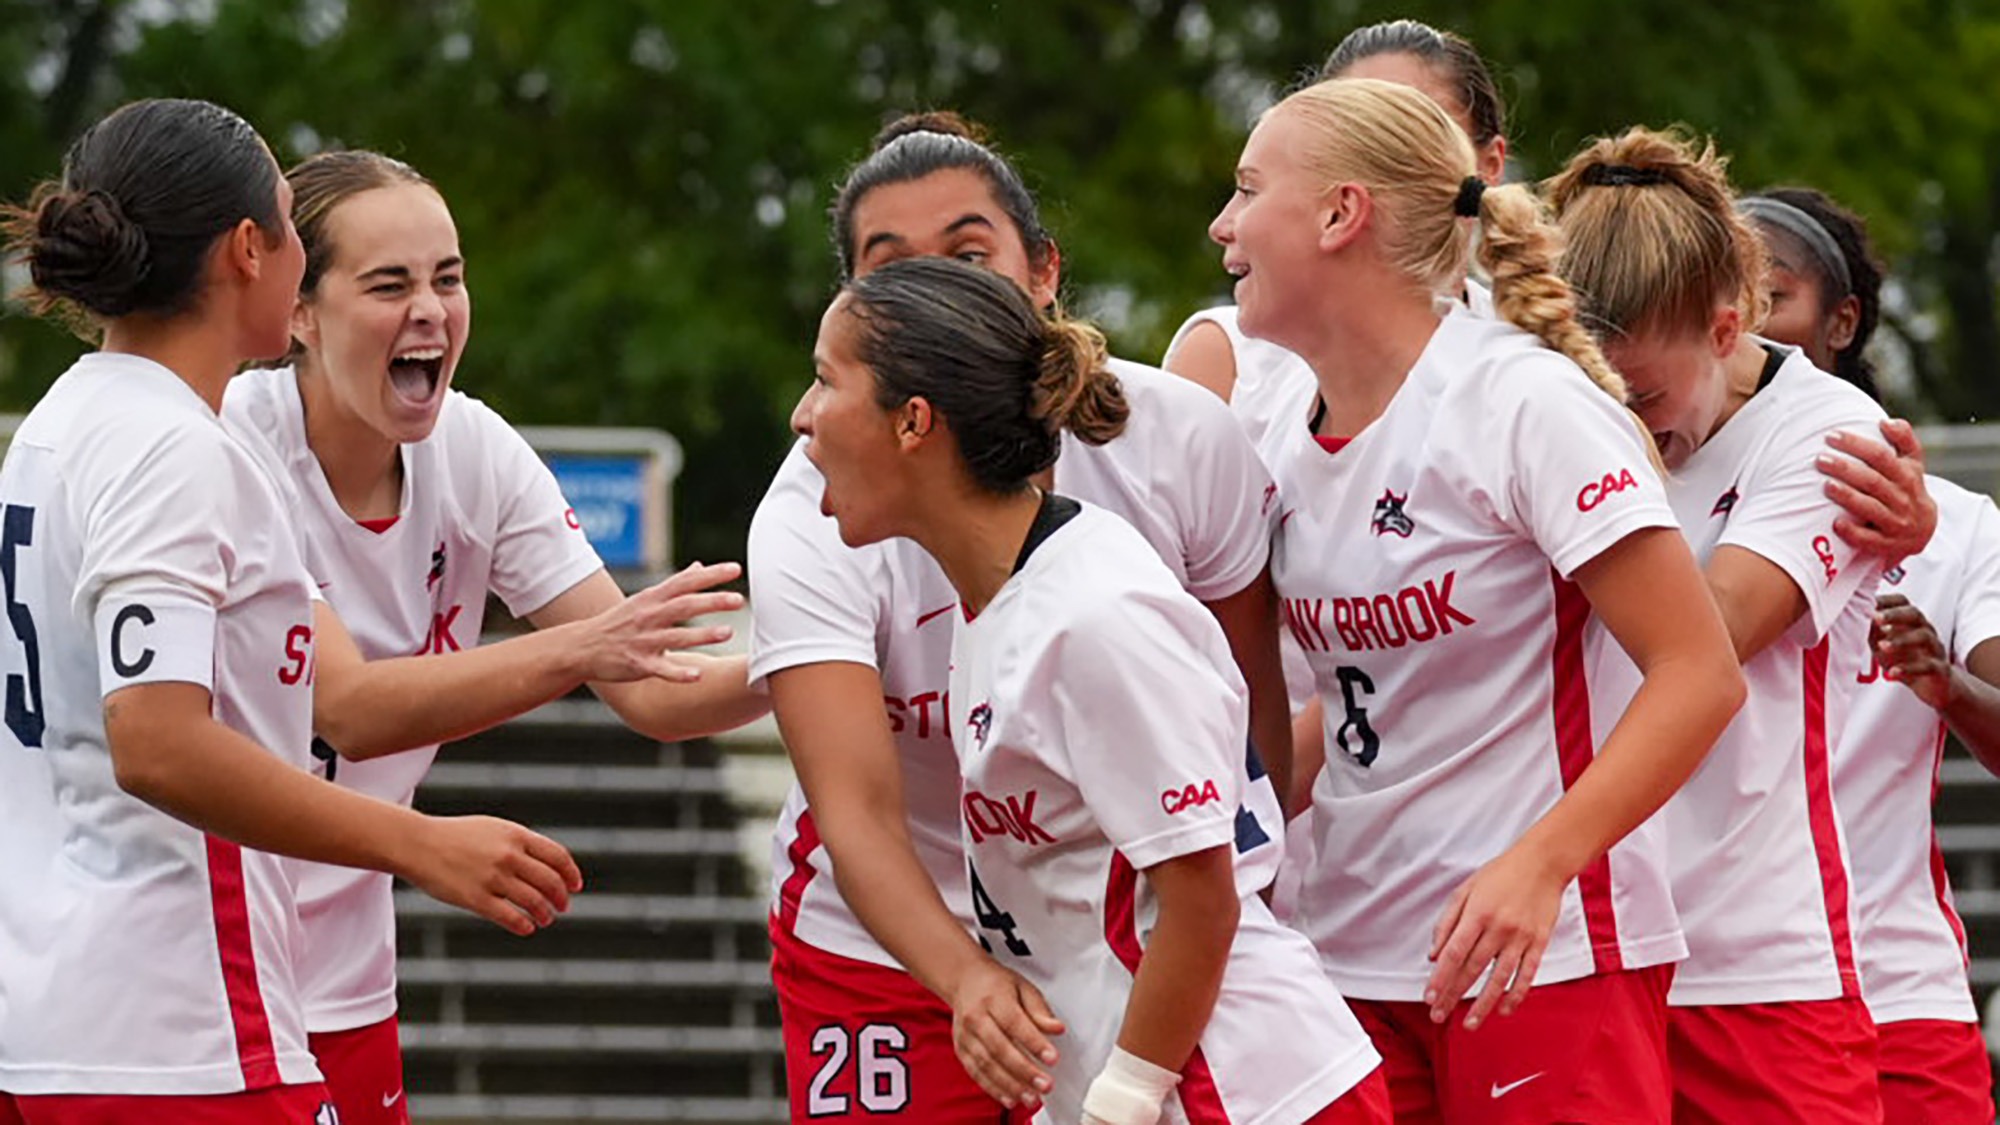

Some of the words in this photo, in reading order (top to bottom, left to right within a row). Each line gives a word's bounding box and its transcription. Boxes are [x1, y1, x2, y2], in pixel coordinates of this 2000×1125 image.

[1577, 468, 1638, 512] CAA
[110, 603, 155, 678] C
[1332, 570, 1476, 651] BROOK
[1336, 666, 1380, 768] 6
[1161, 779, 1221, 815] CAA
[808, 1023, 910, 1117] 26
